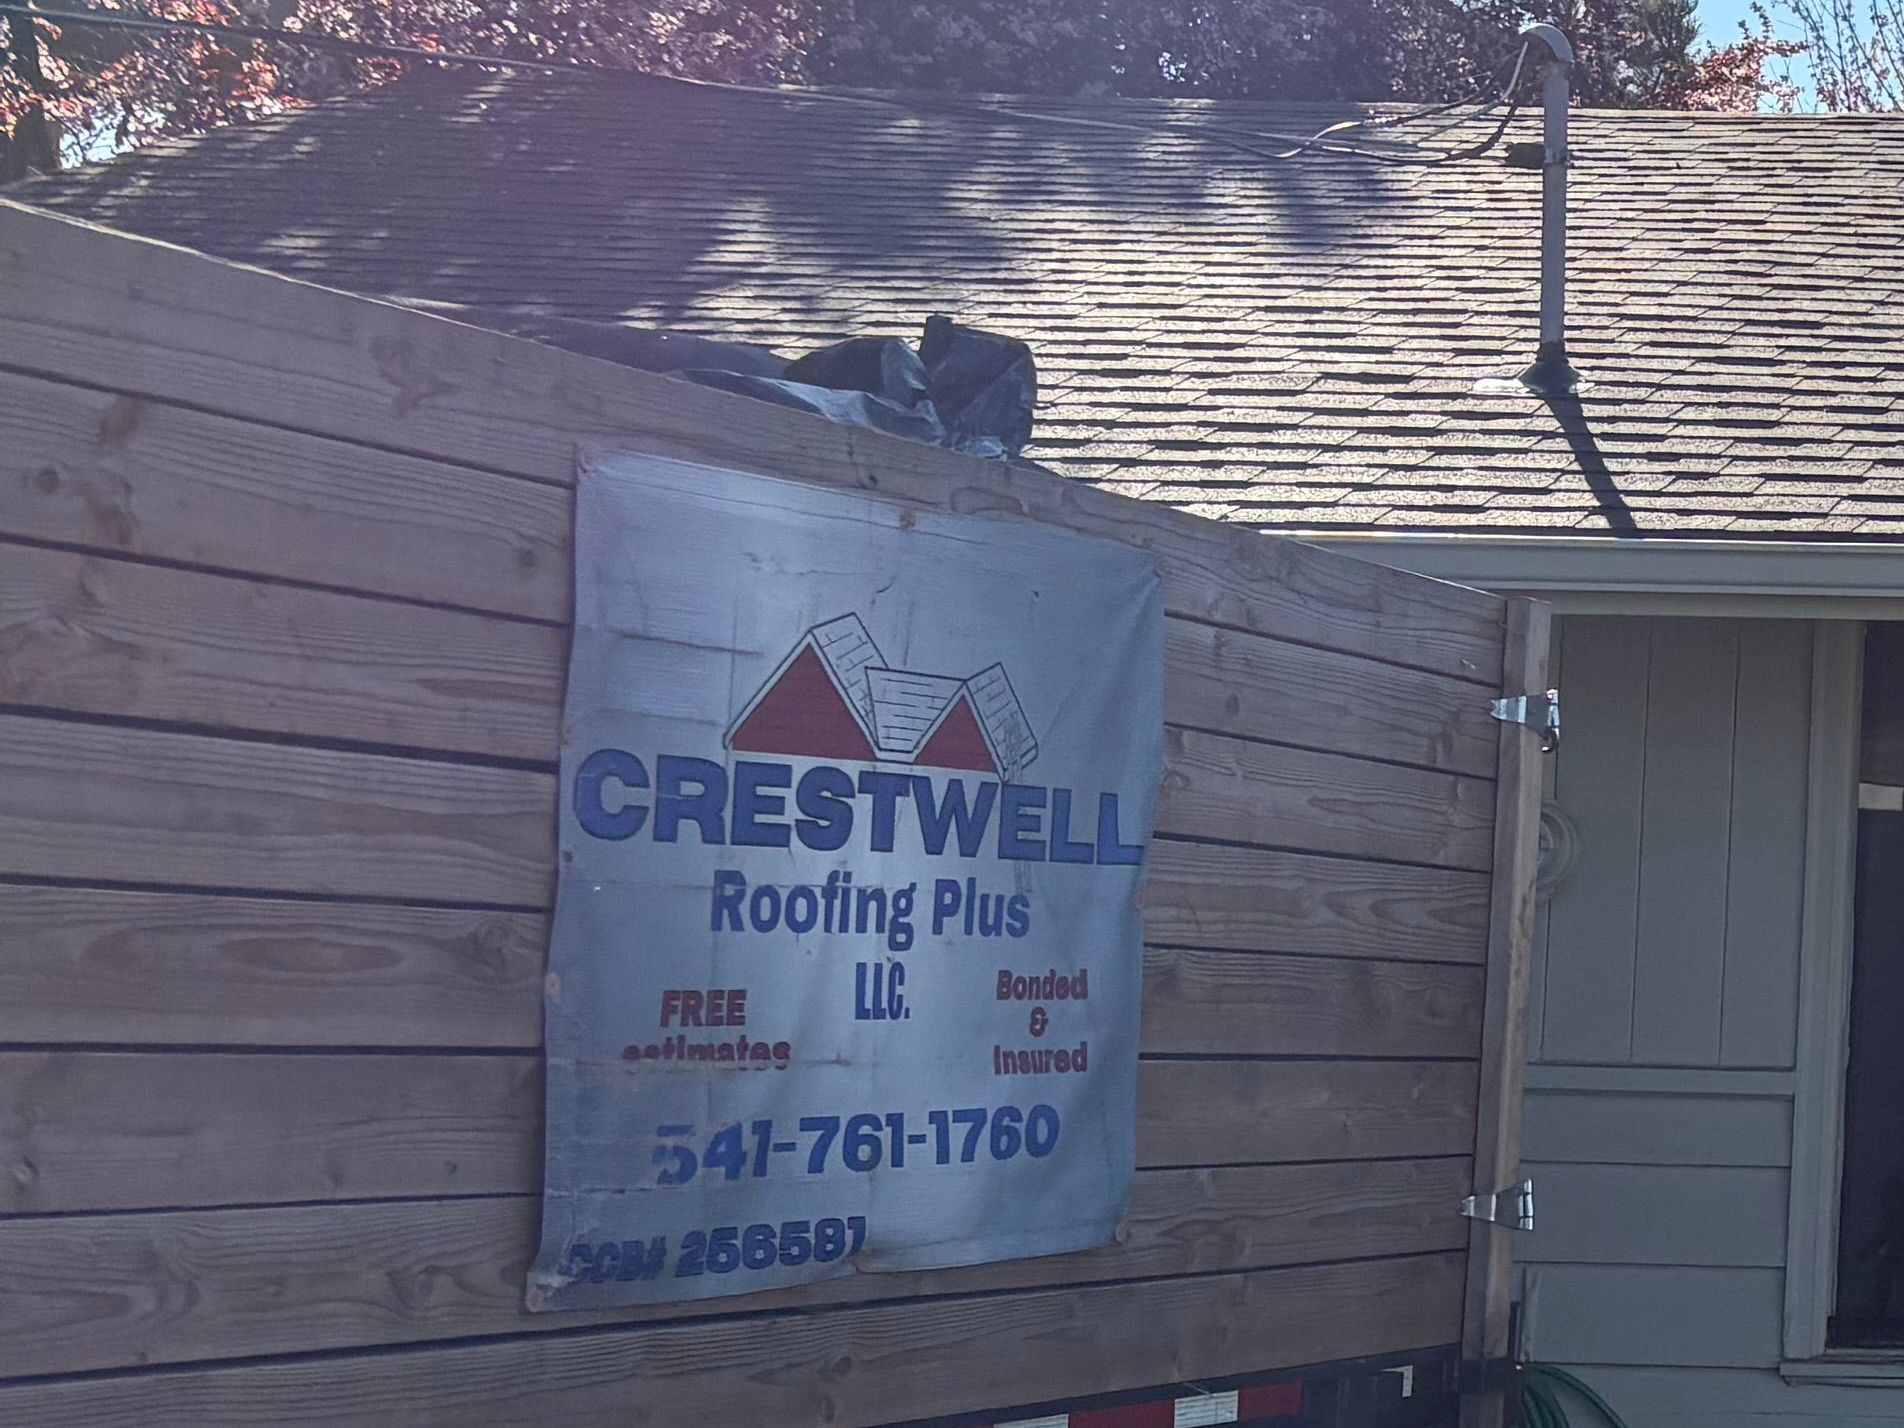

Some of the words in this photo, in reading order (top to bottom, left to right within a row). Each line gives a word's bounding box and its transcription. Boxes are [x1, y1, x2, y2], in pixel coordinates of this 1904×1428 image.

[574, 748, 1146, 865] CRESTWELL
[710, 869, 918, 952] Roofing
[931, 877, 1031, 938] Plus
[854, 961, 911, 1020] LLC.
[996, 968, 1089, 1001] Bonded
[659, 988, 748, 1028] FREE
[1028, 1006, 1049, 1037] &
[620, 1034, 791, 1071] estimates
[993, 1040, 1089, 1075] Insured
[654, 1105, 1060, 1184] 541-761-1760
